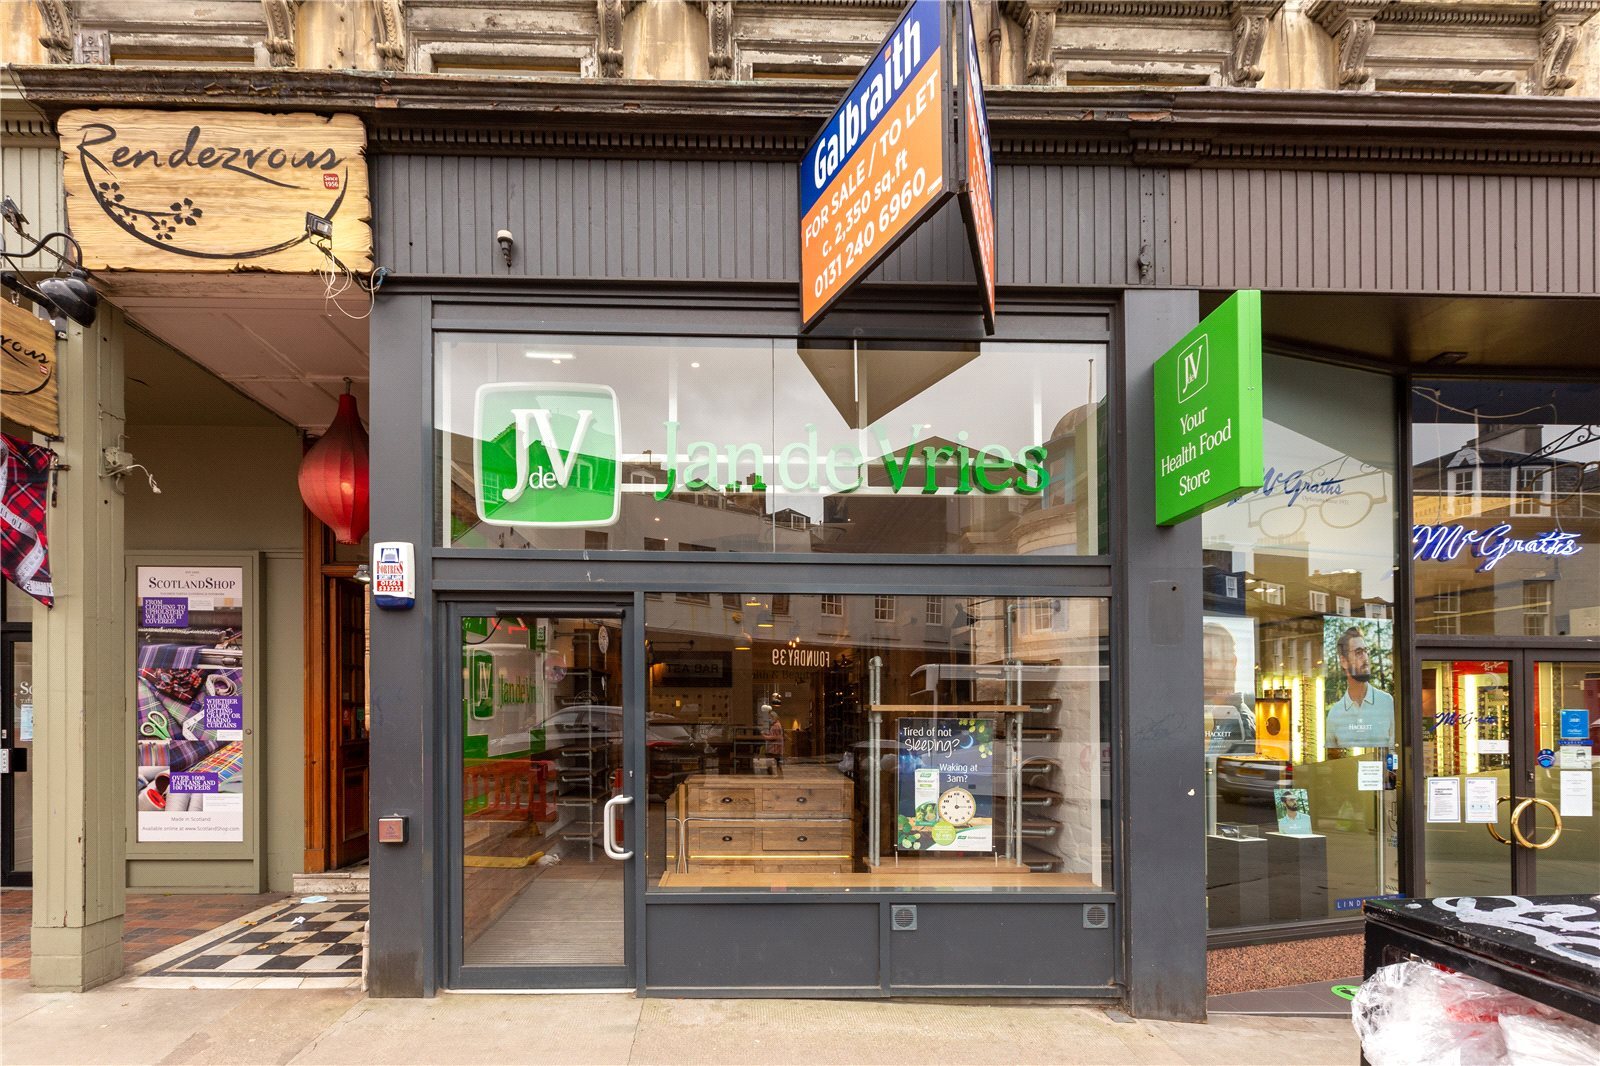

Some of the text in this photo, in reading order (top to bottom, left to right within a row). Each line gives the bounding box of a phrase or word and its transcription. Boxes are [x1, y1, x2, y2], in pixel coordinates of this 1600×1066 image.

[814, 18, 921, 189] Galbraith
[77, 123, 347, 190] Rendezvous
[805, 206, 829, 247] FOR
[831, 162, 865, 215] SALE
[879, 116, 903, 150] TO
[906, 69, 938, 129] LET
[834, 189, 871, 241] 2,350
[874, 148, 908, 201] sq.ft
[814, 166, 926, 298] 0131 240 6960
[1180, 407, 1207, 435] Your
[654, 421, 1051, 501] Jan de Vries
[1161, 418, 1231, 477] Health Food
[529, 466, 557, 489] de
[1179, 468, 1211, 496] Store
[903, 727, 952, 737] Tired of not
[904, 738, 960, 758] Sleeping?
[939, 763, 978, 773] Waking at
[946, 774, 968, 783] 3am?
